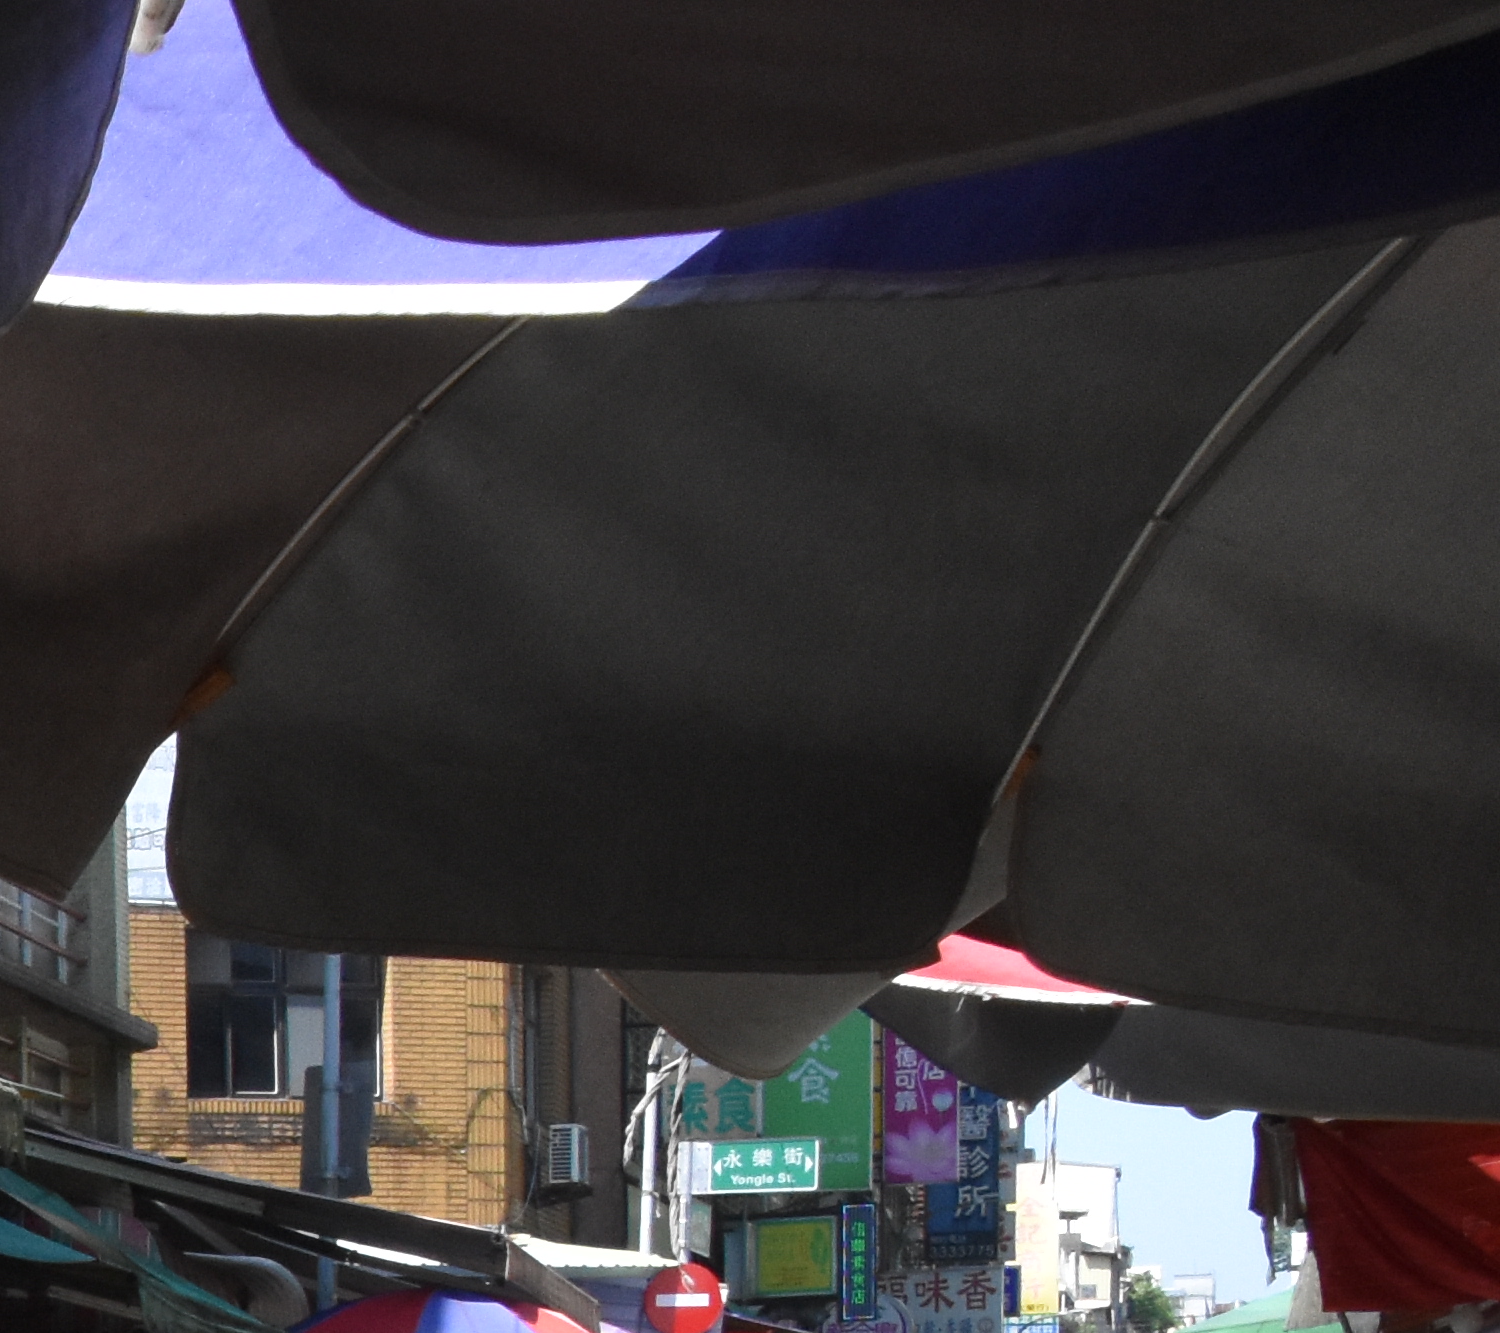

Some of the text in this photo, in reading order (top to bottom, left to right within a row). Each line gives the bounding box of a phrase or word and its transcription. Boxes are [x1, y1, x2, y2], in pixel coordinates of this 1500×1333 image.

[894, 1037, 918, 1112] 信可靠
[670, 1077, 756, 1133] 素食
[722, 1147, 804, 1169] 永樂街
[954, 1086, 999, 1218] 醫診所
[729, 1174, 775, 1187] Yongle
